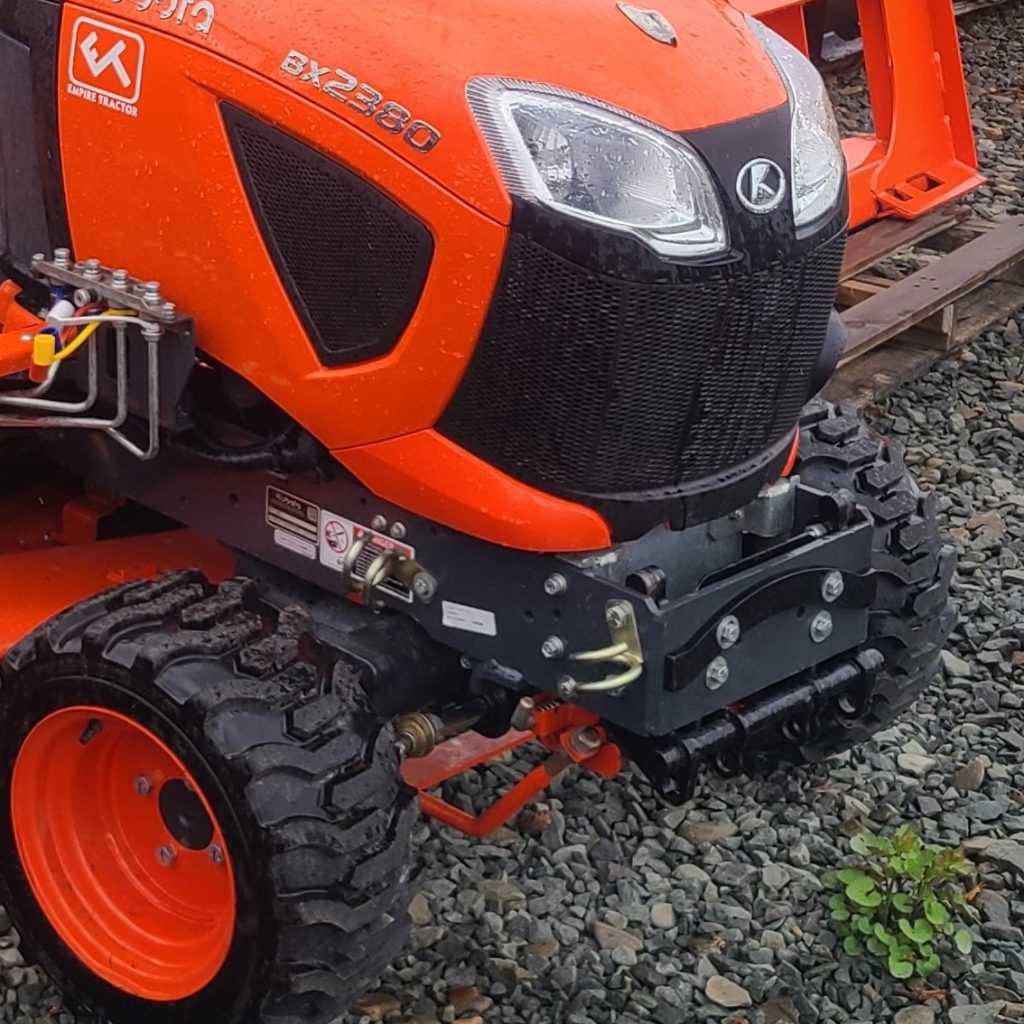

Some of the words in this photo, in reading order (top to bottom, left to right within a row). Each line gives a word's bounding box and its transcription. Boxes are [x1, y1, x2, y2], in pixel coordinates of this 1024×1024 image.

[67, 83, 97, 103] EMPIRE
[98, 93, 138, 118] TRACTOR
[280, 49, 440, 153] BX2380
